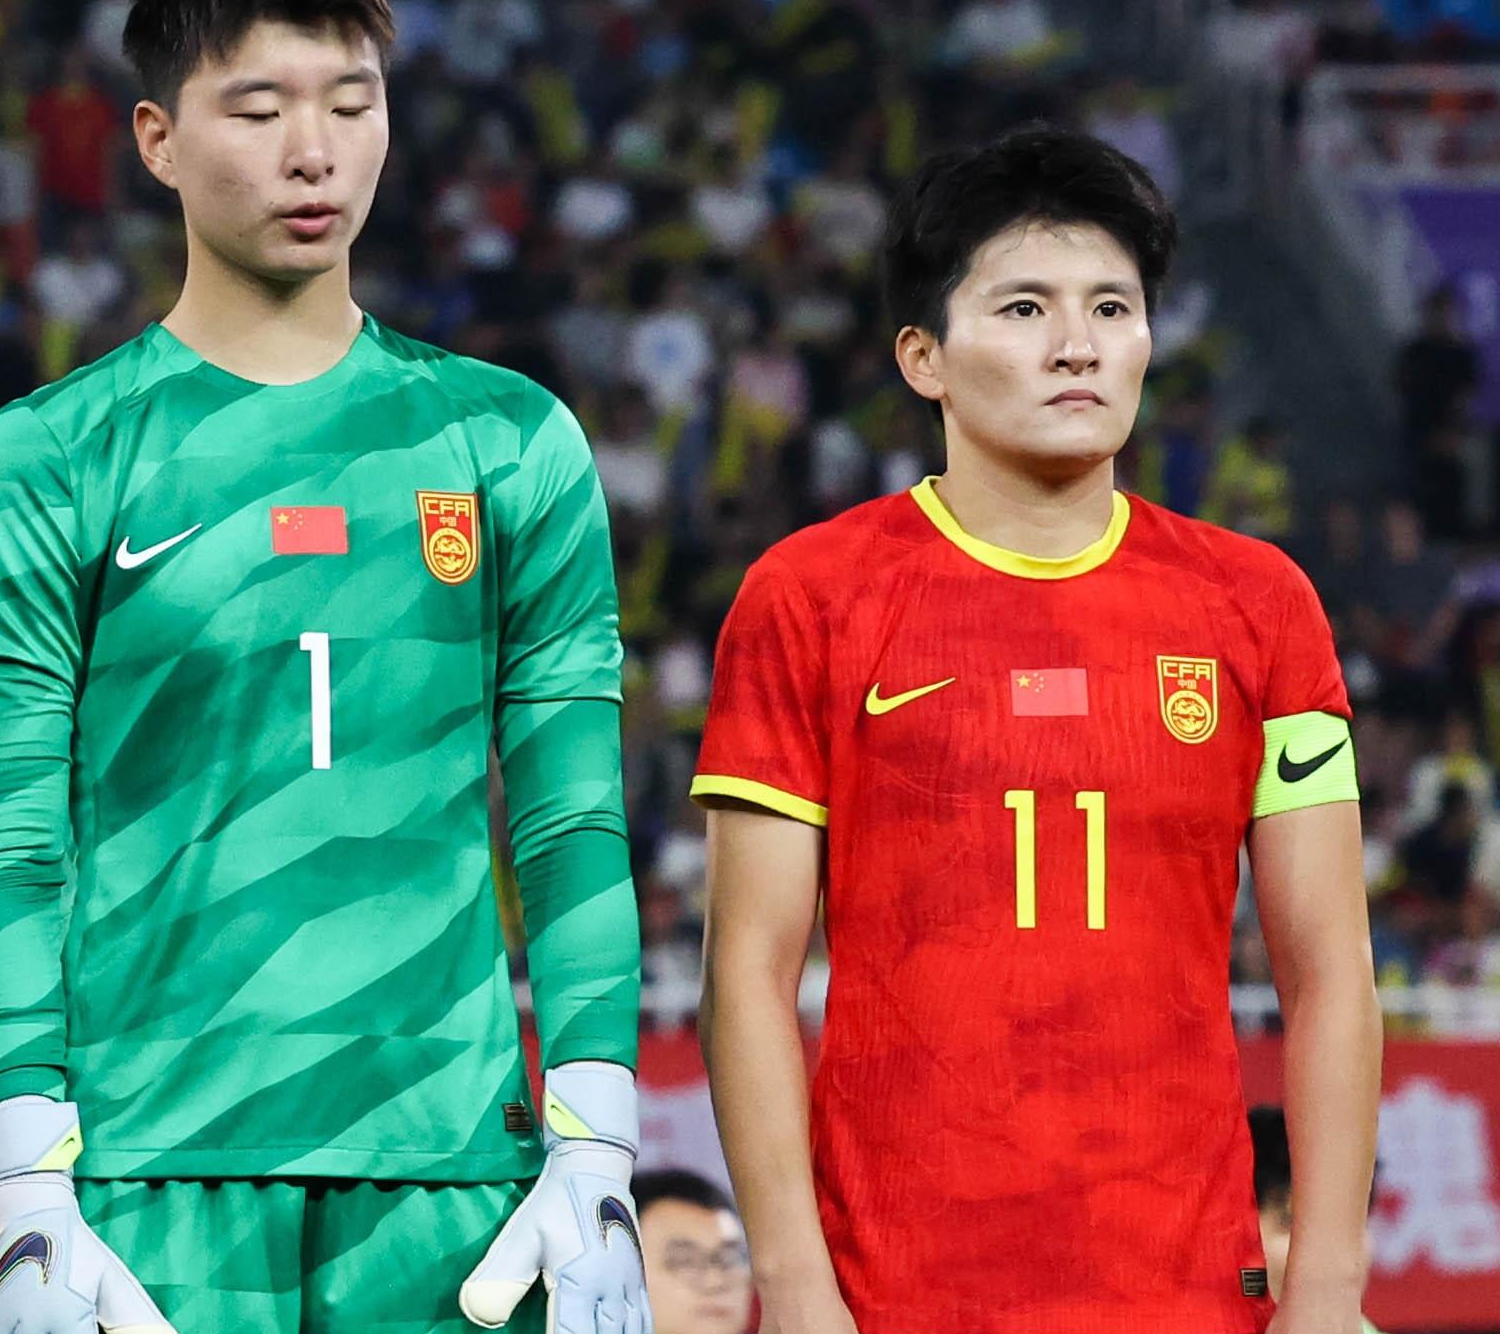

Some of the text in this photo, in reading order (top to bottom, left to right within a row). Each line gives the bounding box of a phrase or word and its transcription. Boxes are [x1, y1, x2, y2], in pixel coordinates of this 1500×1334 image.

[424, 498, 469, 517] CFA
[299, 631, 332, 770] 1
[1163, 661, 1211, 680] CFA
[1004, 789, 1107, 931] 11
